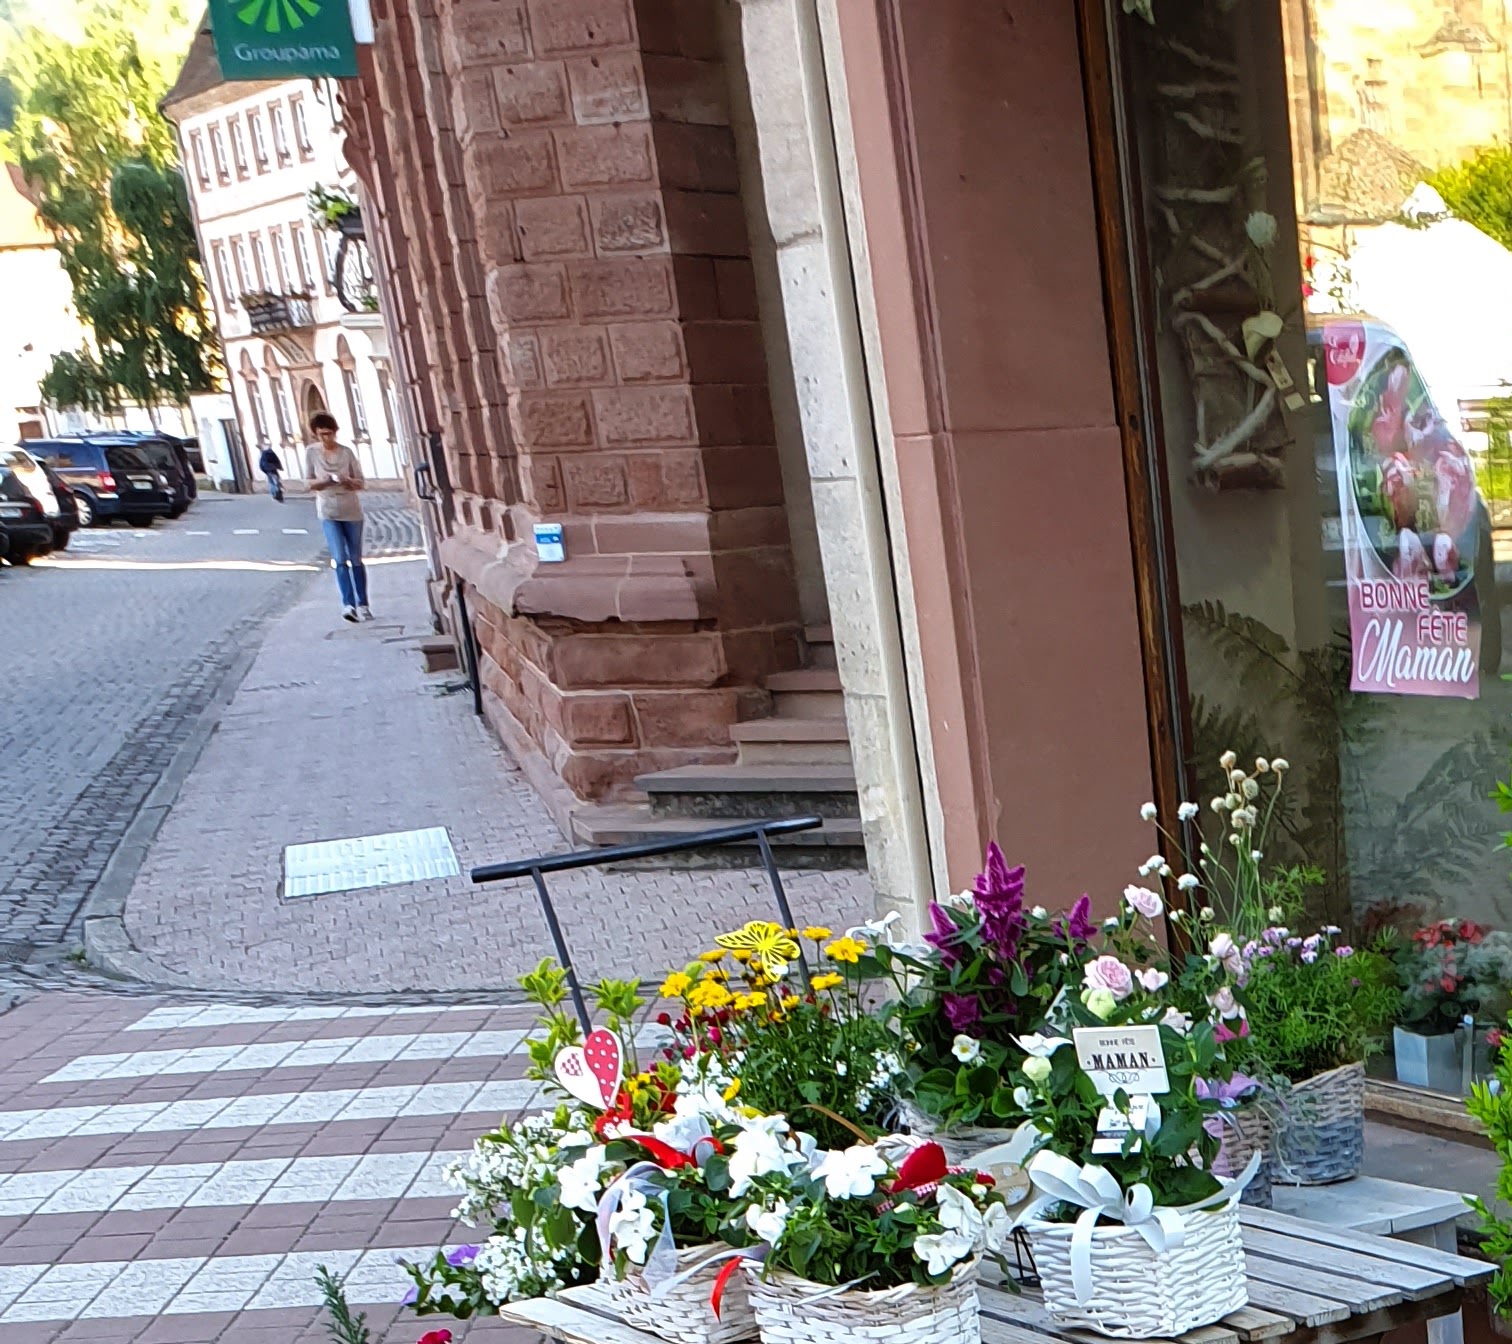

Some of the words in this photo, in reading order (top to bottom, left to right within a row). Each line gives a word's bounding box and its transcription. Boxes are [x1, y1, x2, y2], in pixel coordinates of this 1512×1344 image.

[233, 43, 341, 61] Groupama
[1361, 582, 1431, 610] BONNE
[1418, 608, 1468, 643] FÊTE
[1358, 617, 1475, 688] Maman
[1091, 1052, 1151, 1070] MAMAN
